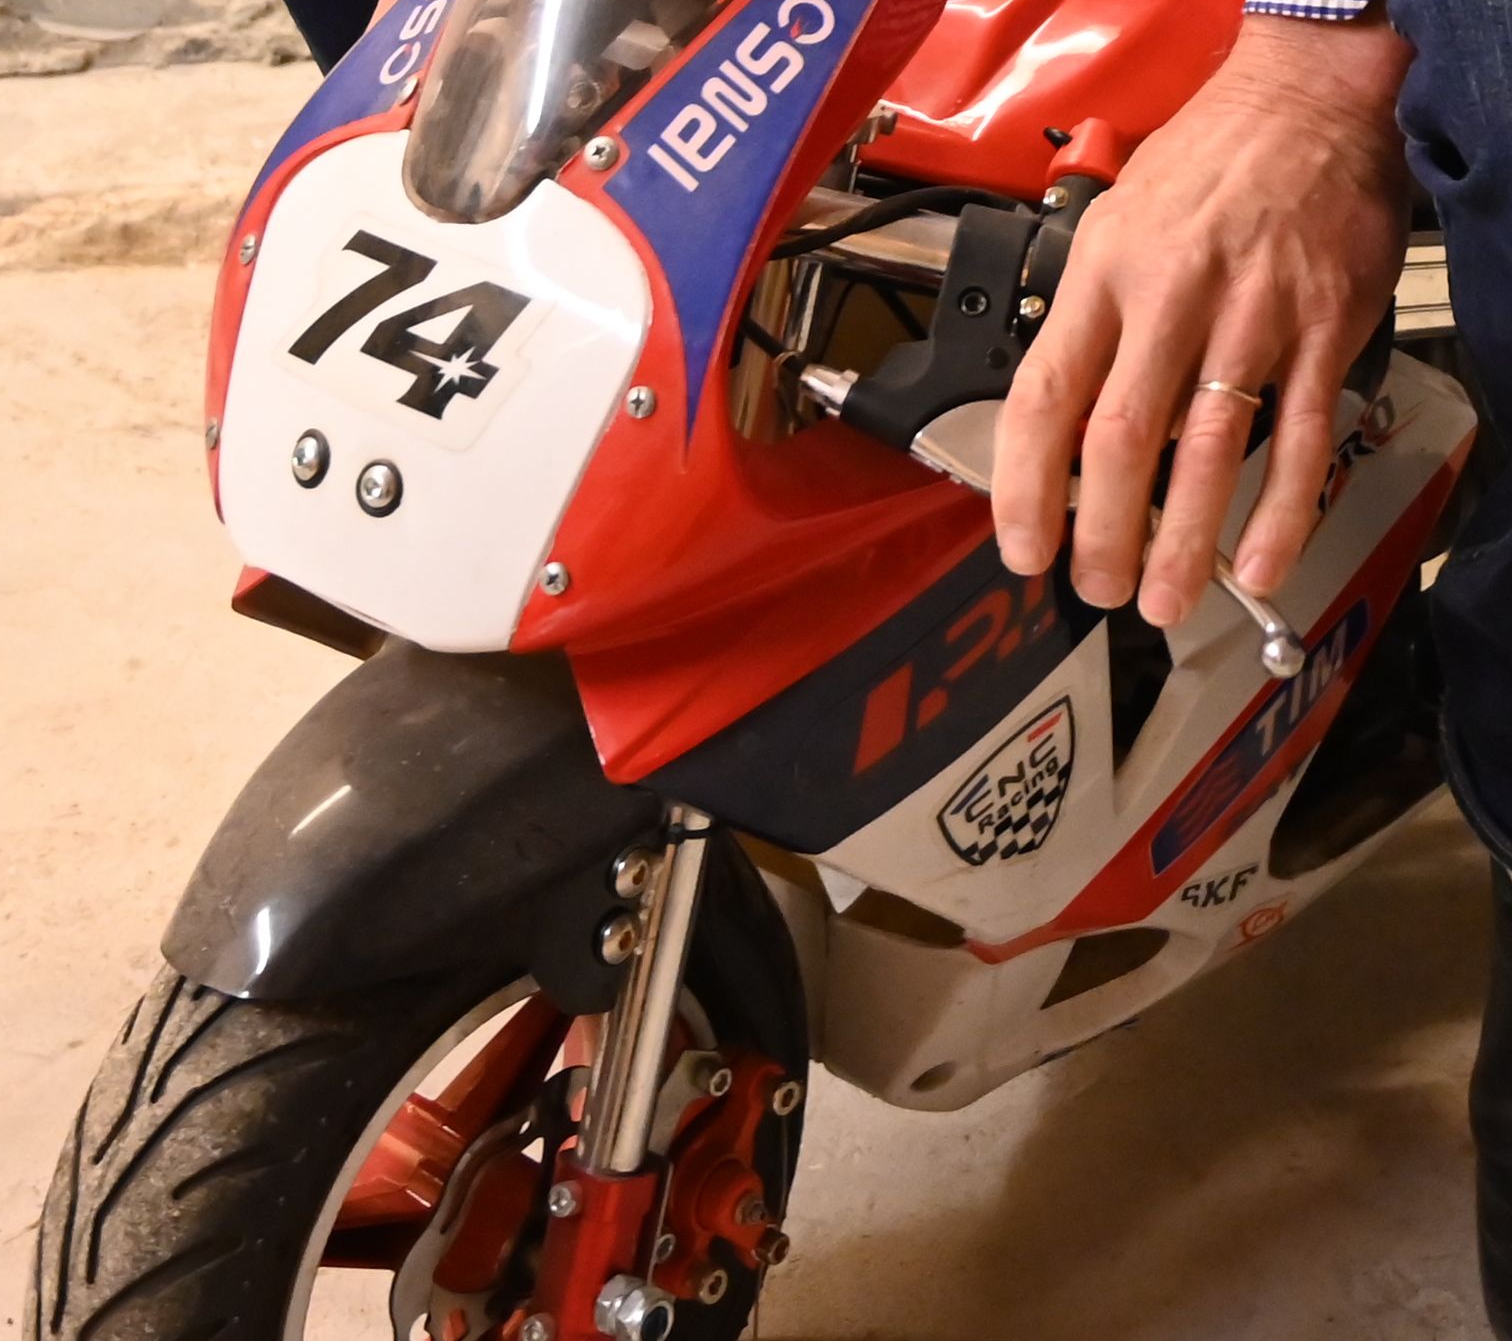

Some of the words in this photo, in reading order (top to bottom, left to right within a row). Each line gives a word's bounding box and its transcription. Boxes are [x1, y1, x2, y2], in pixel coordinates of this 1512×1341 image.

[288, 229, 532, 420] 74
[1256, 617, 1349, 757] TIM
[964, 733, 1058, 824] CNC
[978, 756, 1060, 835] Racing
